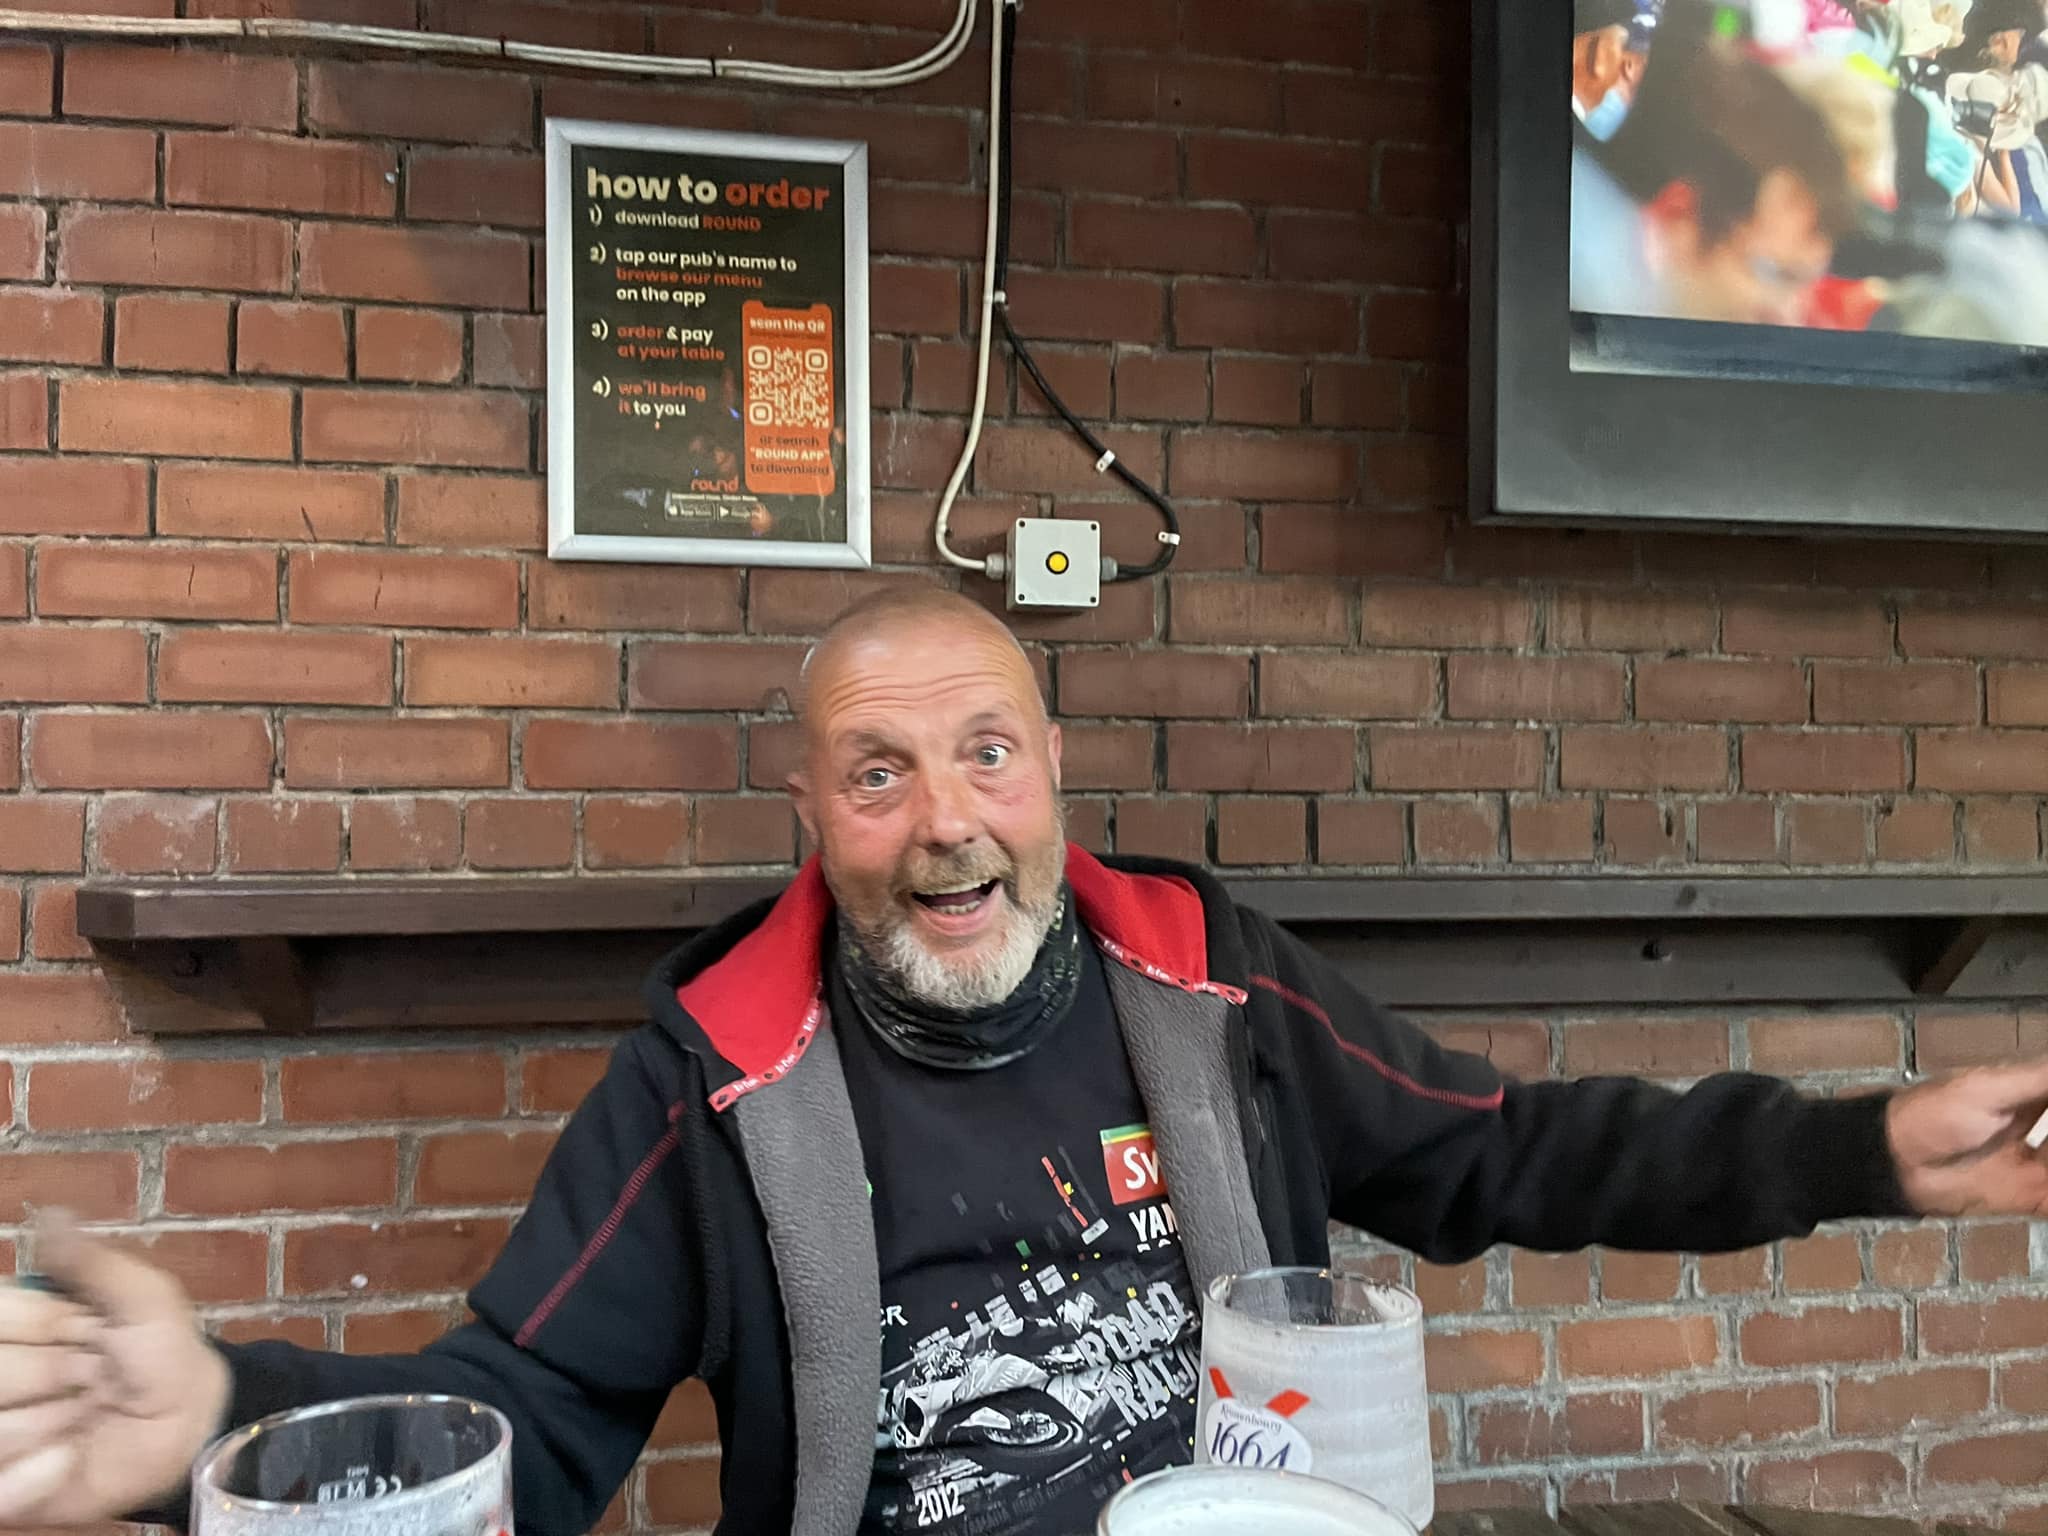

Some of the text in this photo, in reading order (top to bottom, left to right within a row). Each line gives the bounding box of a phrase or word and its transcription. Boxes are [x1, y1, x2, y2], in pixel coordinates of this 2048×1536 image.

[587, 166, 830, 210] how to order
[589, 204, 762, 232] 1) download ROUND
[590, 242, 797, 271] 2) tap our pub's name to
[616, 267, 763, 288] browse our menu
[616, 287, 706, 307] on the app
[591, 319, 713, 344] 3) order & pay
[783, 318, 806, 331] the
[617, 344, 725, 361] at your table
[592, 376, 707, 401] 4) we'll bring
[619, 400, 686, 420] it to you
[690, 474, 740, 493] round
[914, 1482, 966, 1527] 2012
